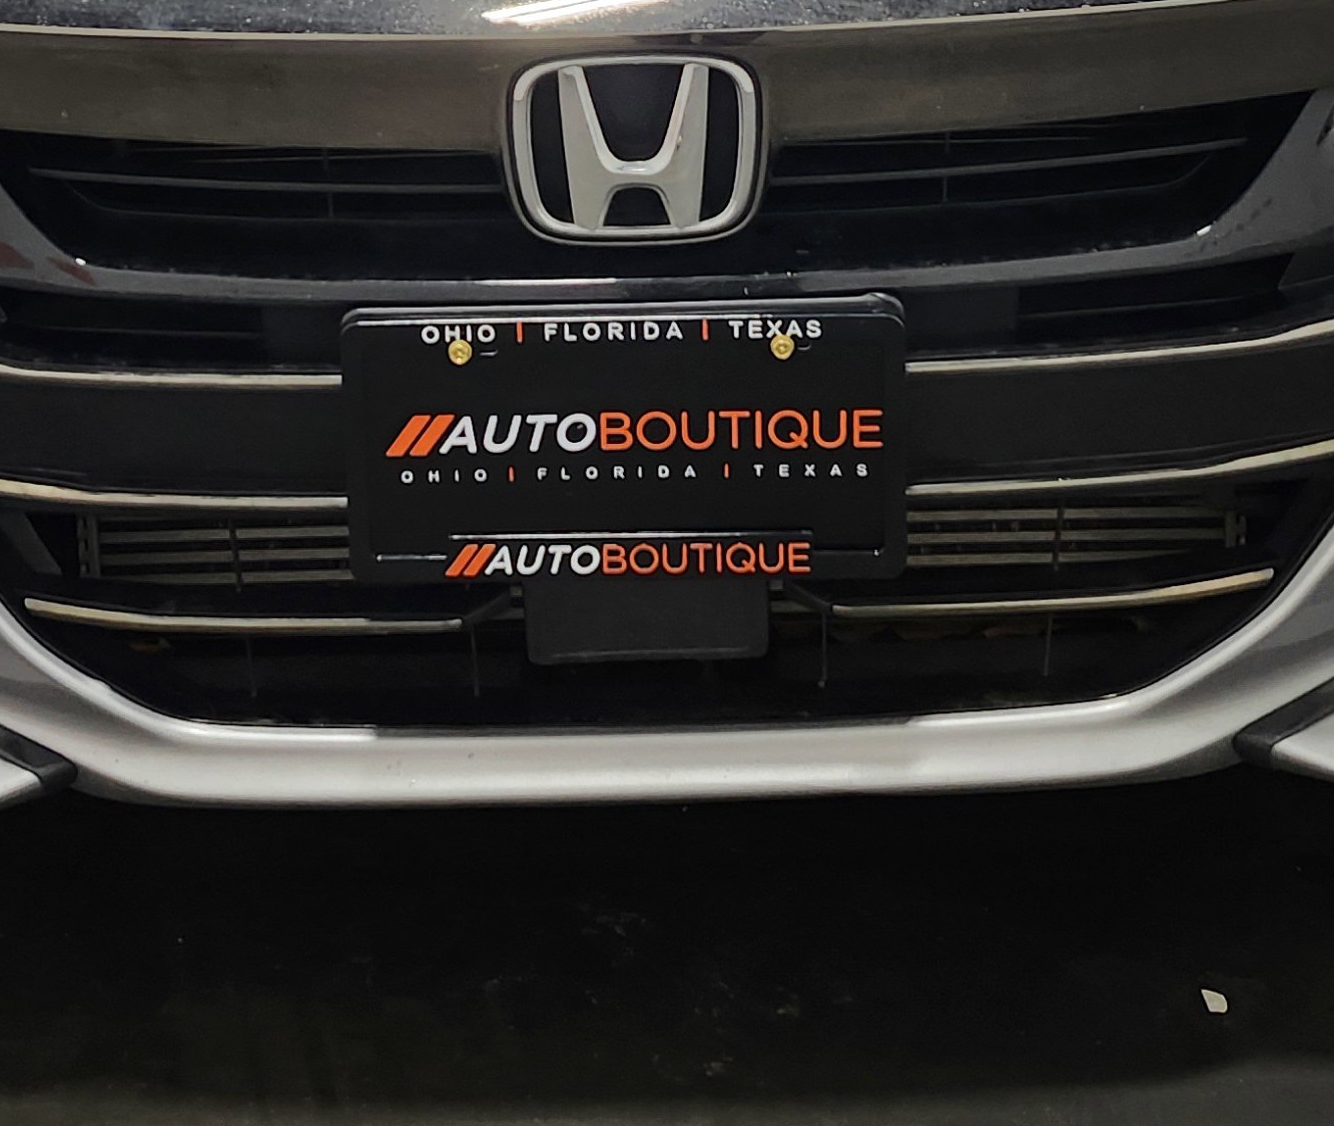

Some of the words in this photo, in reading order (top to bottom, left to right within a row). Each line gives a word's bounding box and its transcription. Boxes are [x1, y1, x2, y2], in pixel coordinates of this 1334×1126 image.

[421, 324, 496, 344] OHIO
[544, 321, 683, 342] FLORIDA
[728, 319, 822, 339] TEXAS
[438, 409, 884, 454] AUTOBOUTIQUE
[401, 469, 487, 484] OHIO
[537, 466, 697, 481] FLORIDA
[753, 463, 868, 478] TEXAS
[484, 542, 811, 576] AUTOBOUTIQUE
